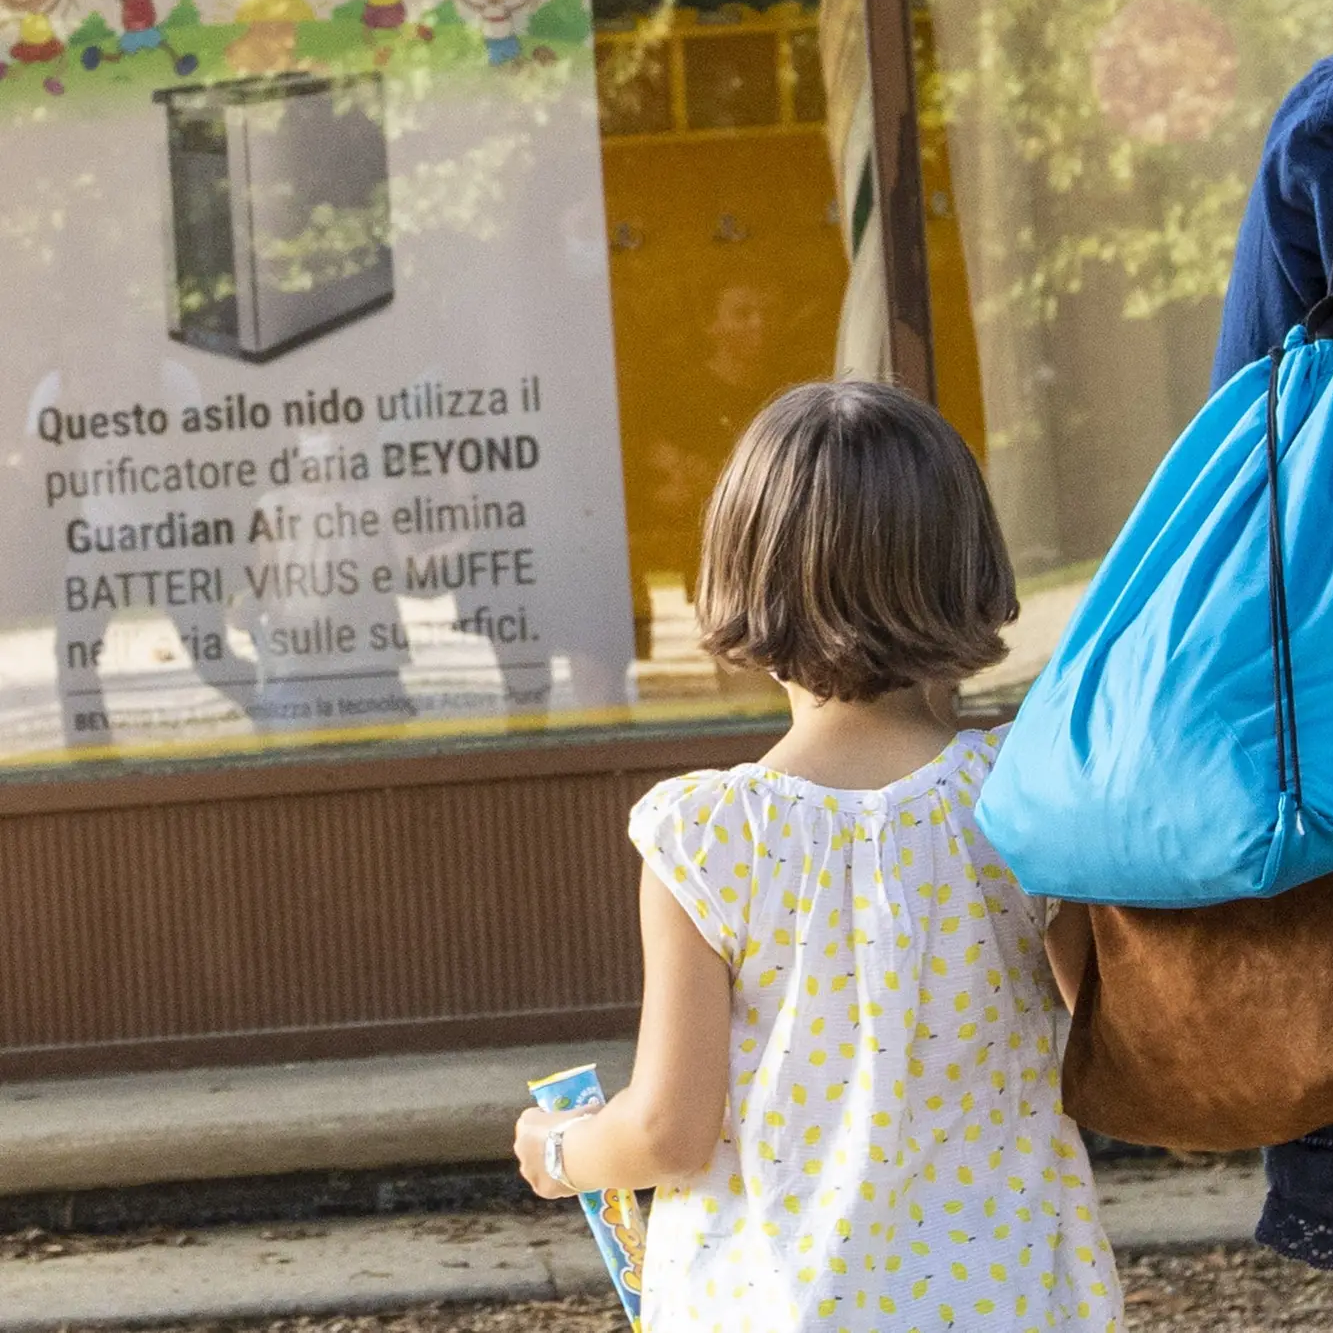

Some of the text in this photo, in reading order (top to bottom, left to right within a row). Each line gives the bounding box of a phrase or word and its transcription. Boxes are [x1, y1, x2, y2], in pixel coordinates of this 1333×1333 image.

[38, 374, 541, 446] Questo asilo nido utilizza il
[45, 434, 540, 508] purificatore d'aria BEYOND
[66, 494, 527, 554] Guardian Air che elimina
[245, 556, 360, 600] VIRUS
[372, 563, 393, 595] e
[406, 546, 537, 592] MUFFE
[270, 614, 356, 658] sulle
[370, 605, 541, 652] surfici.
